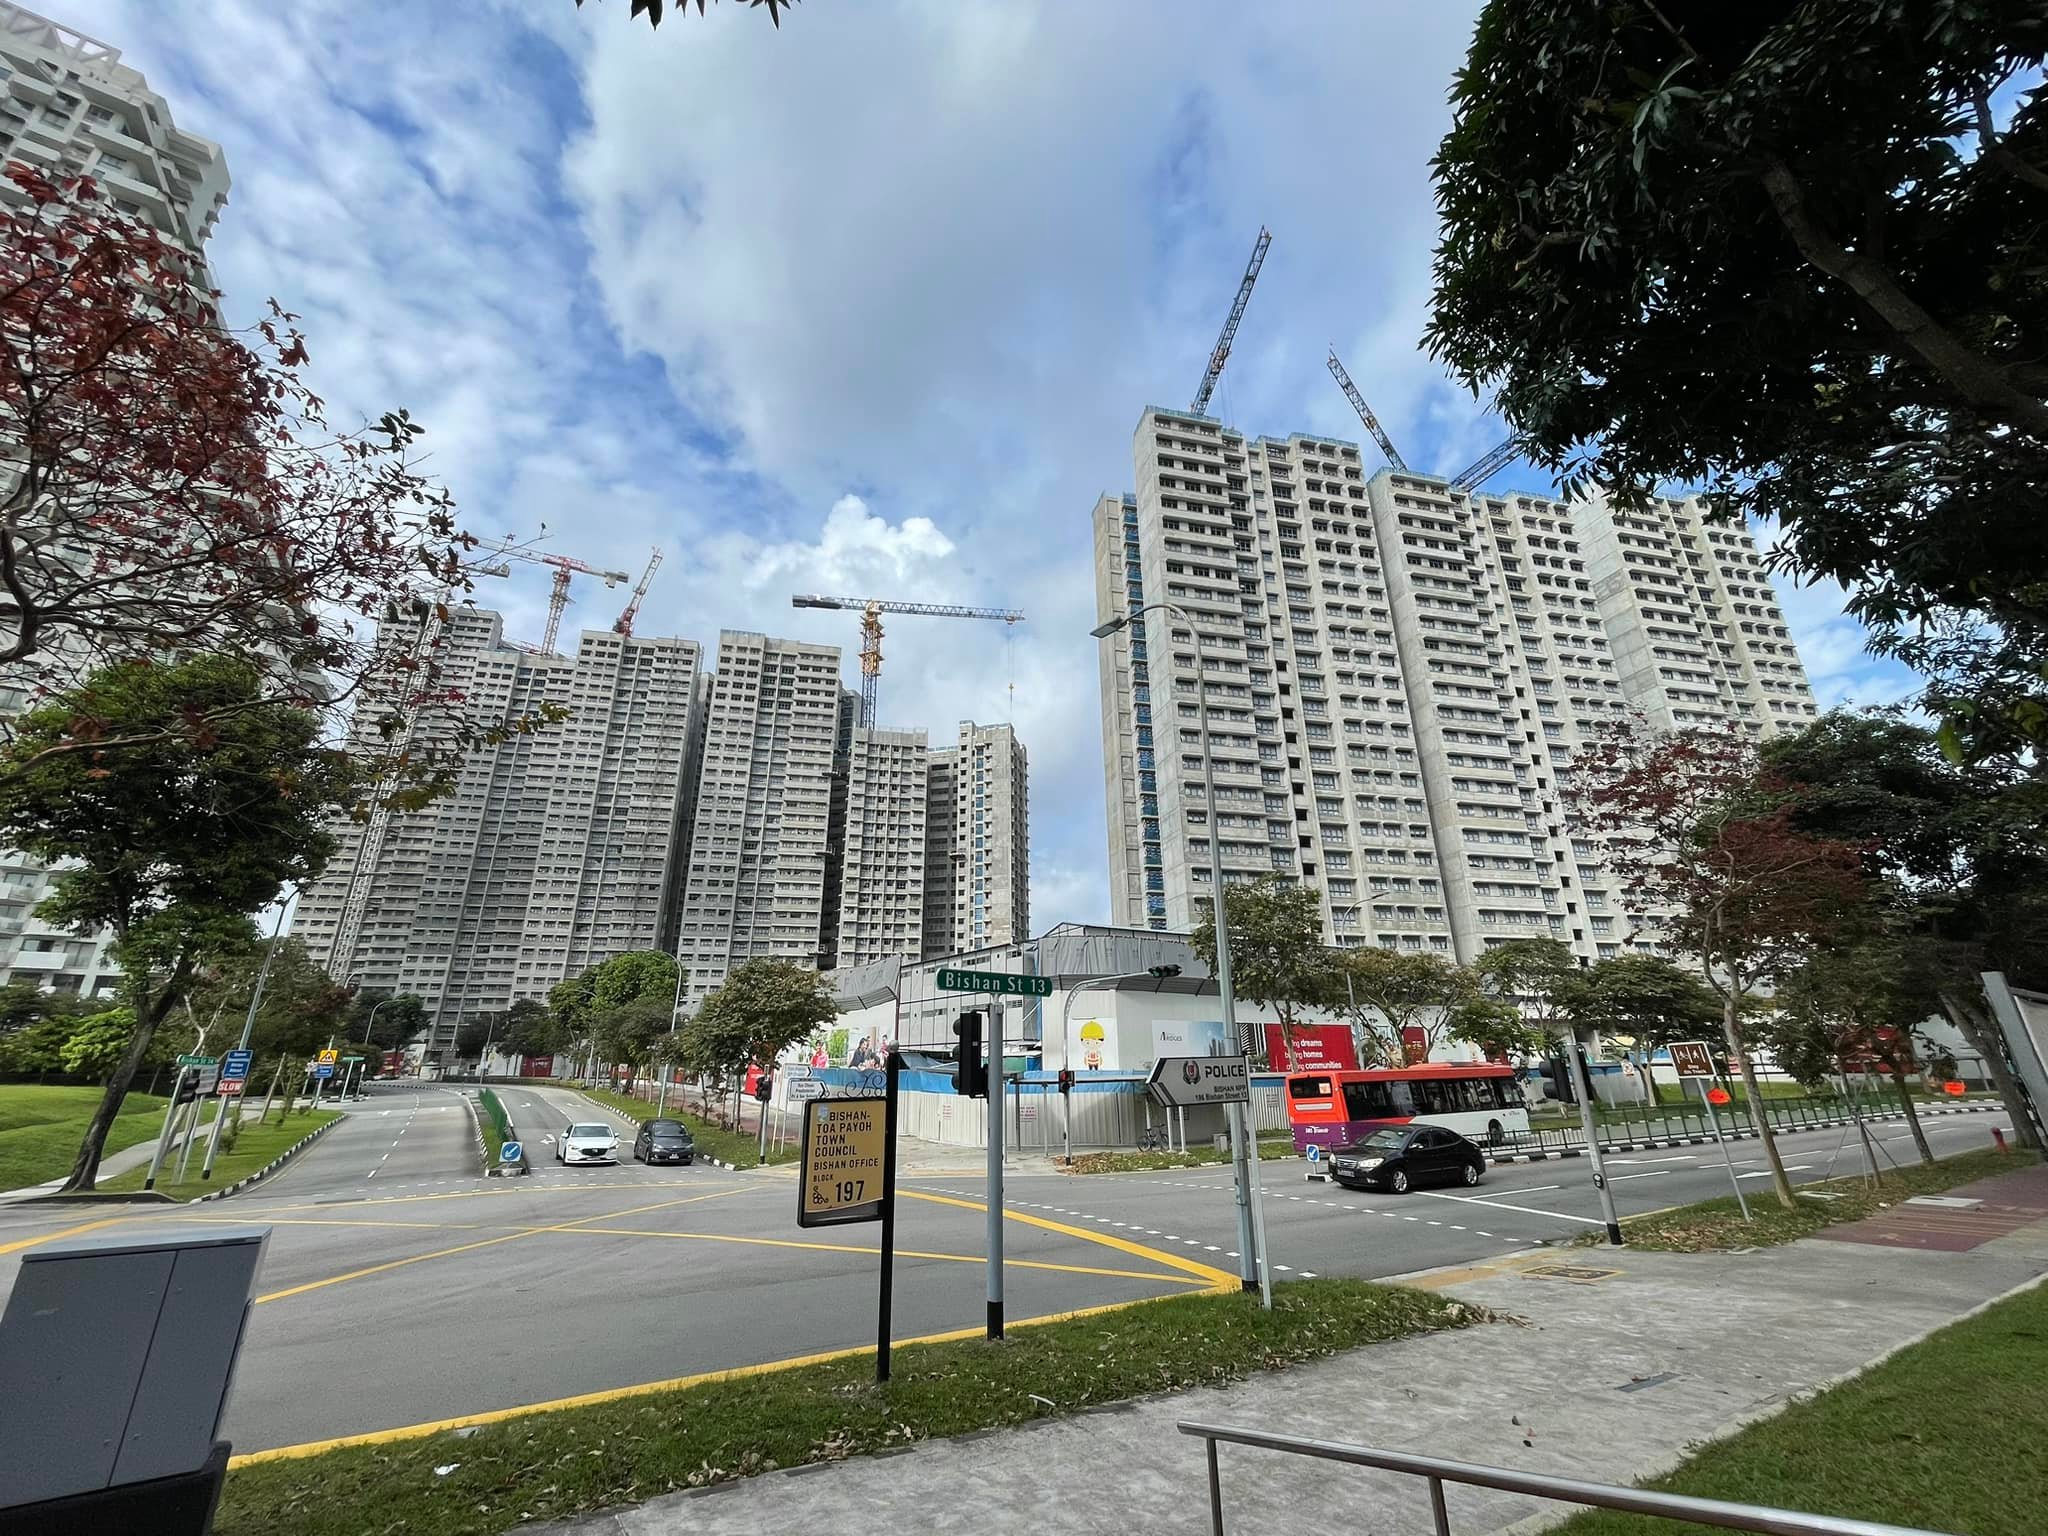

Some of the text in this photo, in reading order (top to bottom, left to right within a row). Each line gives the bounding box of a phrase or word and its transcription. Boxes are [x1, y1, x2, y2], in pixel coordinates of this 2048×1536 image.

[945, 972, 1045, 993] Bishan St 13
[1300, 1039, 1323, 1047] dreams
[1303, 1050, 1323, 1058] homes
[1305, 1061, 1342, 1069] communities
[1205, 1065, 1244, 1078] POLICE
[219, 1082, 242, 1091] SLOW
[829, 1111, 870, 1121] BISHAN-
[816, 1121, 872, 1133] TOA PAYOH
[816, 1134, 846, 1145] TOWN
[815, 1146, 857, 1157] COUNCIL
[814, 1158, 879, 1171] BISHAN OFFICE
[813, 1174, 834, 1182] BLOCK
[835, 1180, 865, 1202] 197
